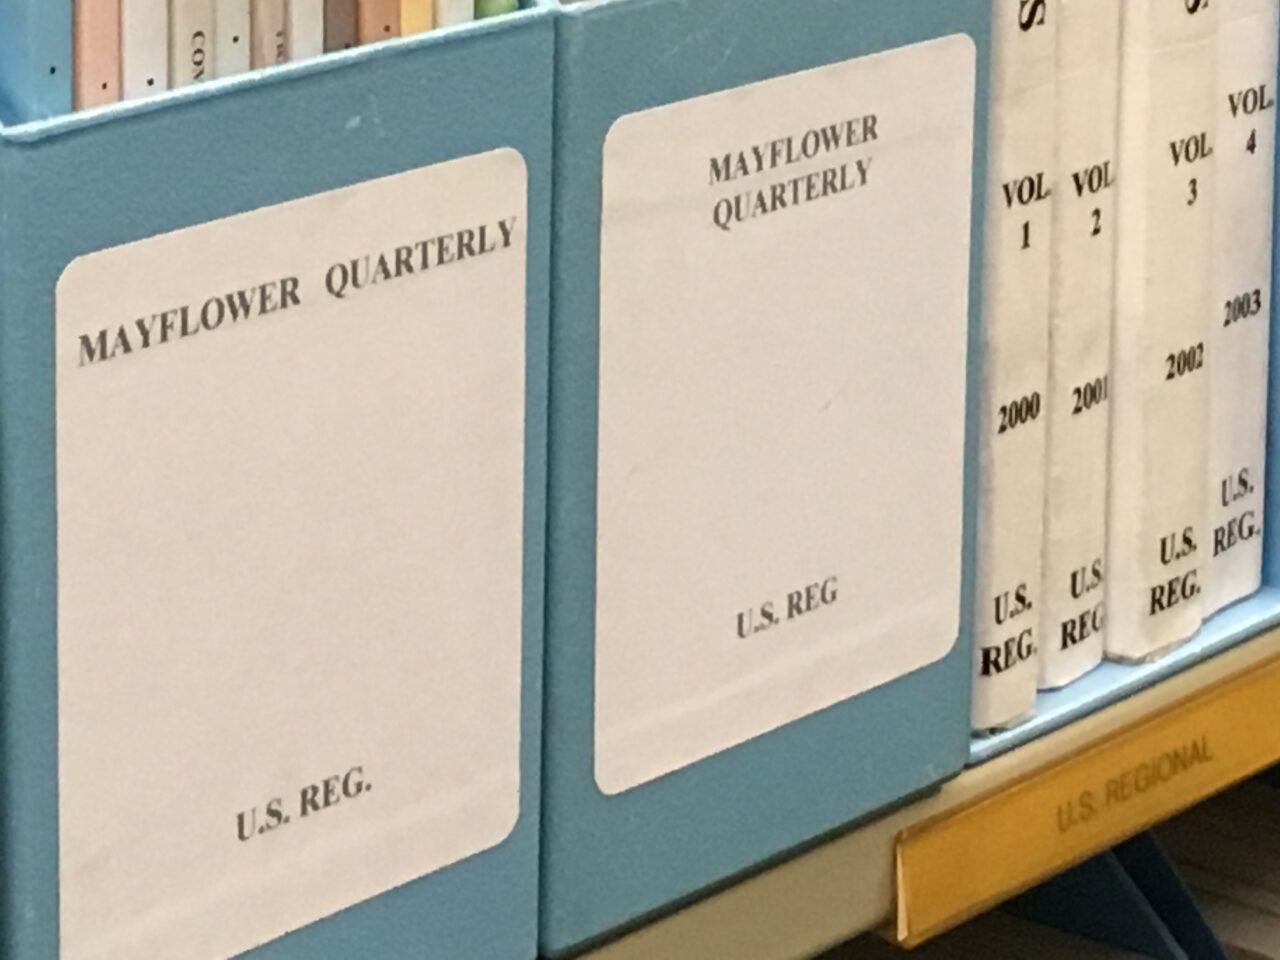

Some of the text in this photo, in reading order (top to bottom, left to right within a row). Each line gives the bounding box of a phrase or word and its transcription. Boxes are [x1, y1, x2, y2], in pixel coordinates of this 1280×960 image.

[1228, 84, 1274, 119] VOL.
[709, 114, 878, 185] MAYFLOWER
[1245, 129, 1257, 155] 4
[712, 157, 873, 231] QUARTERLY
[1187, 178, 1197, 206] 3
[1021, 221, 1031, 249] 1
[1091, 208, 1101, 237] 2
[77, 216, 517, 367] MAYFLOWER QUARTERLY
[1223, 289, 1262, 327] 2003
[1165, 342, 1204, 380] 2002
[997, 392, 1041, 434] 2000
[1221, 467, 1254, 507] U.S.
[1160, 526, 1197, 566] U.S.
[1212, 510, 1261, 558] REG.
[737, 576, 838, 639] U.S. REG
[994, 583, 1032, 625] U.S.
[1149, 570, 1202, 616] REG.
[980, 628, 1038, 678] REG.
[237, 766, 372, 842] U.S. REG.
[1056, 736, 1213, 833] U.S. REGIONAL
